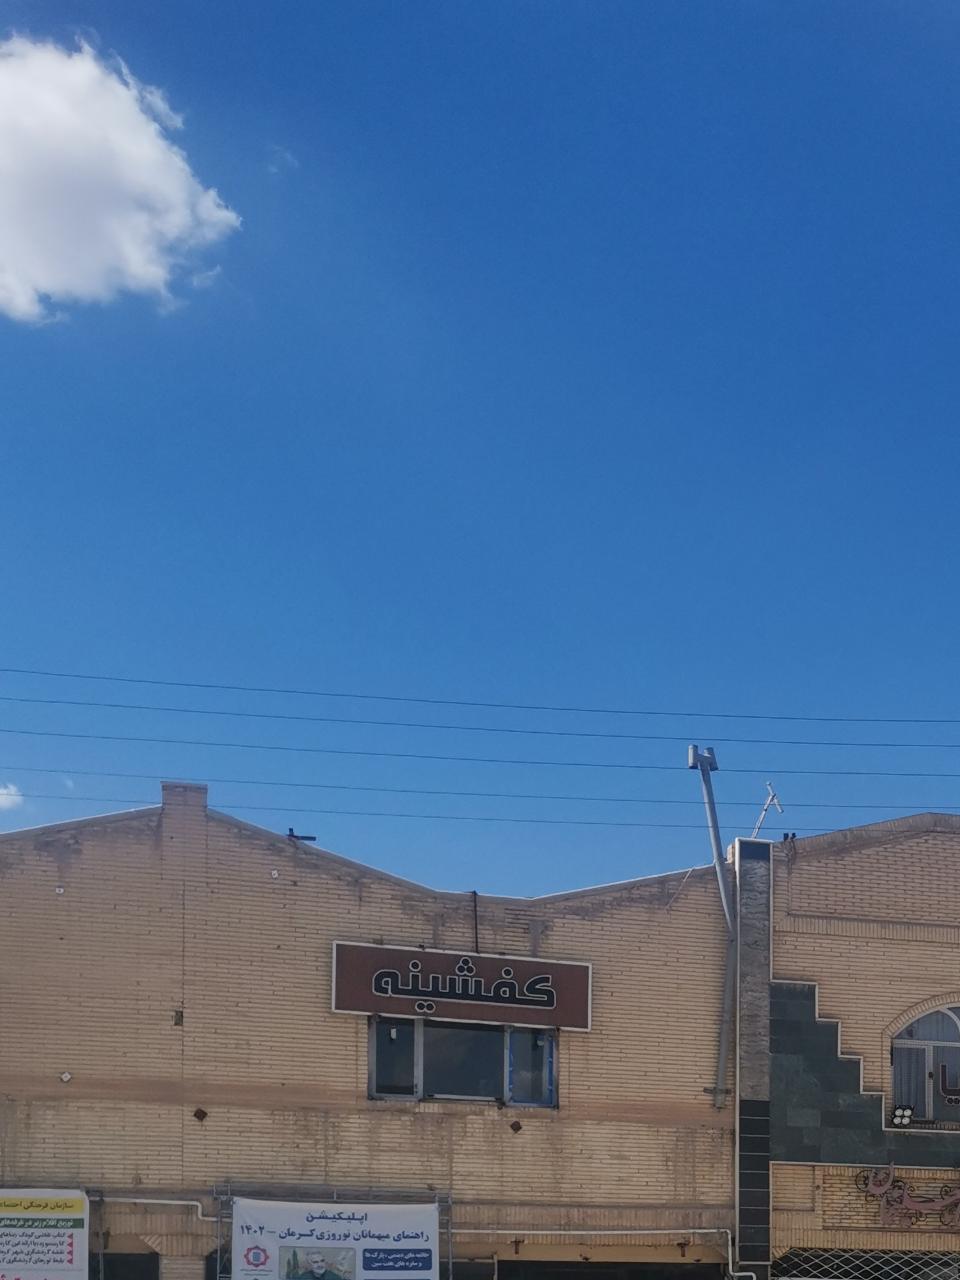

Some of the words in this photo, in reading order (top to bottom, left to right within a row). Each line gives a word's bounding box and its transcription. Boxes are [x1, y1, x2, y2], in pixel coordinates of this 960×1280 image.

[373, 957, 556, 1013] کفشینه
[50, 1202, 75, 1211] سازمان
[306, 1210, 368, 1226] اپلیکیشن
[240, 1225, 265, 1236] ۱۴۰۲
[279, 1229, 316, 1239] کرمان
[316, 1229, 351, 1241] نوروزی
[353, 1230, 391, 1242] میهمانان
[392, 1230, 430, 1242] راهنمای
